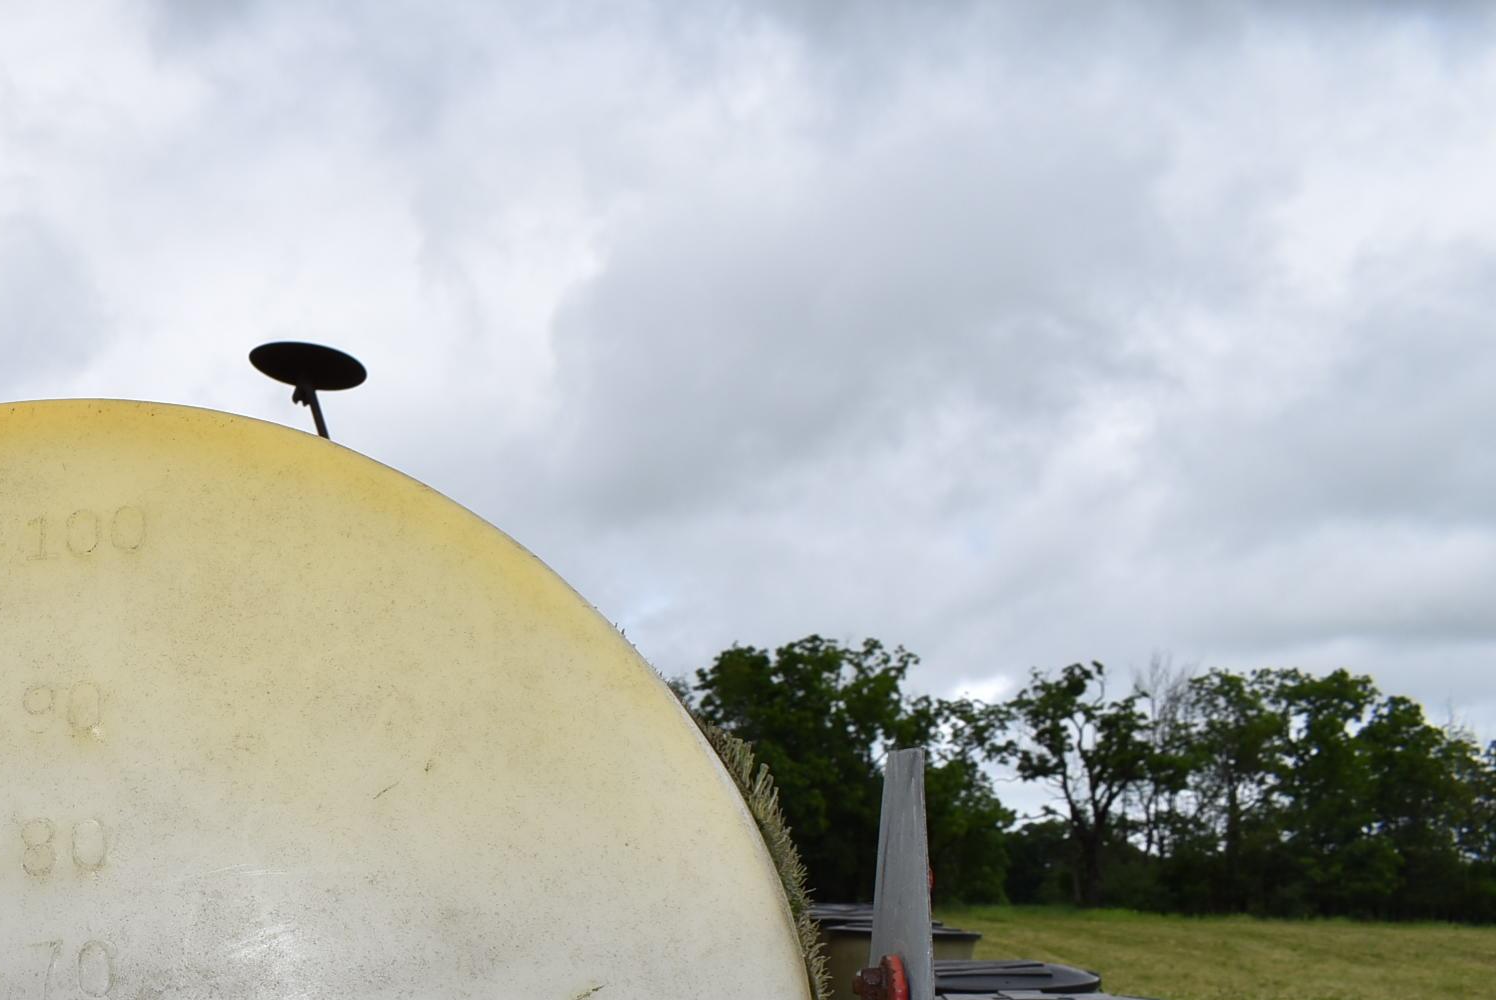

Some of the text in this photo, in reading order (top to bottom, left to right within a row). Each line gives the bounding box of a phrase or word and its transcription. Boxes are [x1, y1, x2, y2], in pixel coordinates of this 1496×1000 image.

[26, 505, 147, 562] 100
[21, 680, 105, 737] 90
[21, 818, 107, 876] 80
[27, 939, 118, 1000] 70
